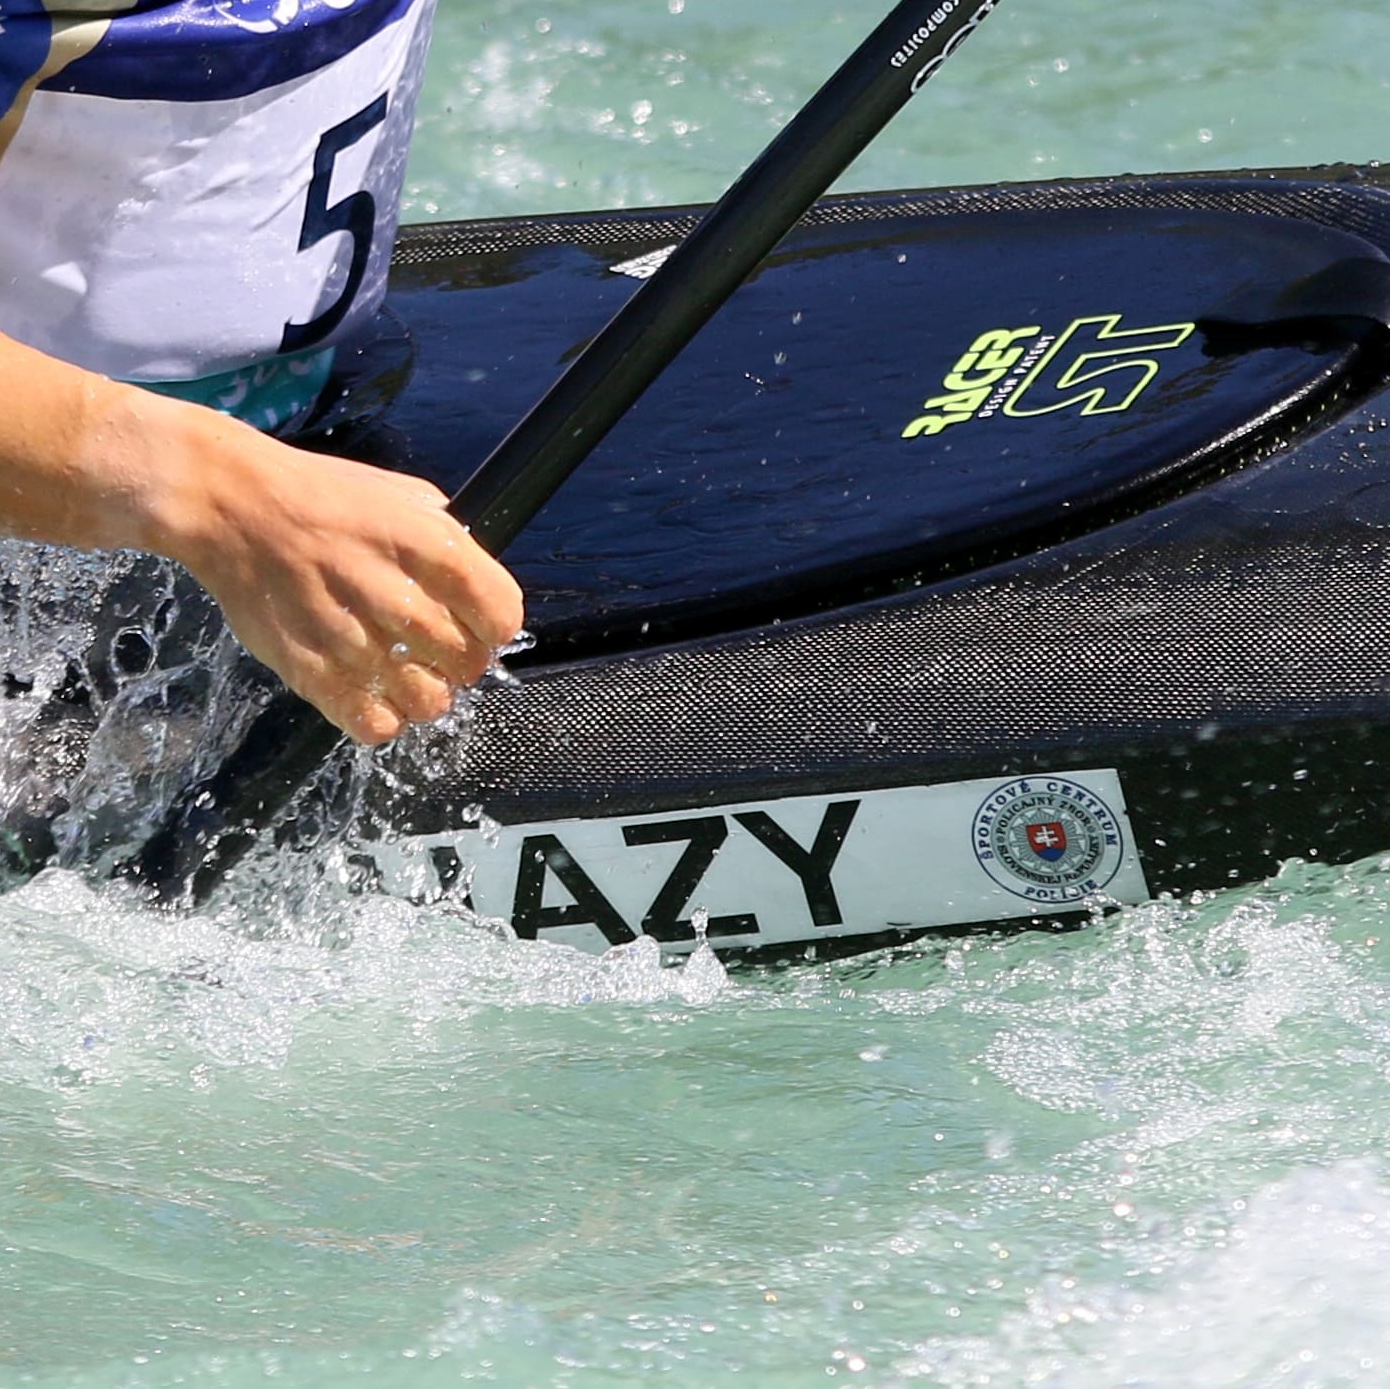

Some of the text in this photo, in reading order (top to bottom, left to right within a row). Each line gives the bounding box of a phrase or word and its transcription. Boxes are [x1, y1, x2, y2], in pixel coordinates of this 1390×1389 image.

[275, 89, 391, 355] 5
[900, 325, 1042, 439] RACER
[978, 334, 1057, 419] DESIGN PATENT
[429, 798, 863, 944] AZY
[1046, 781, 1119, 847] CENTRUM
